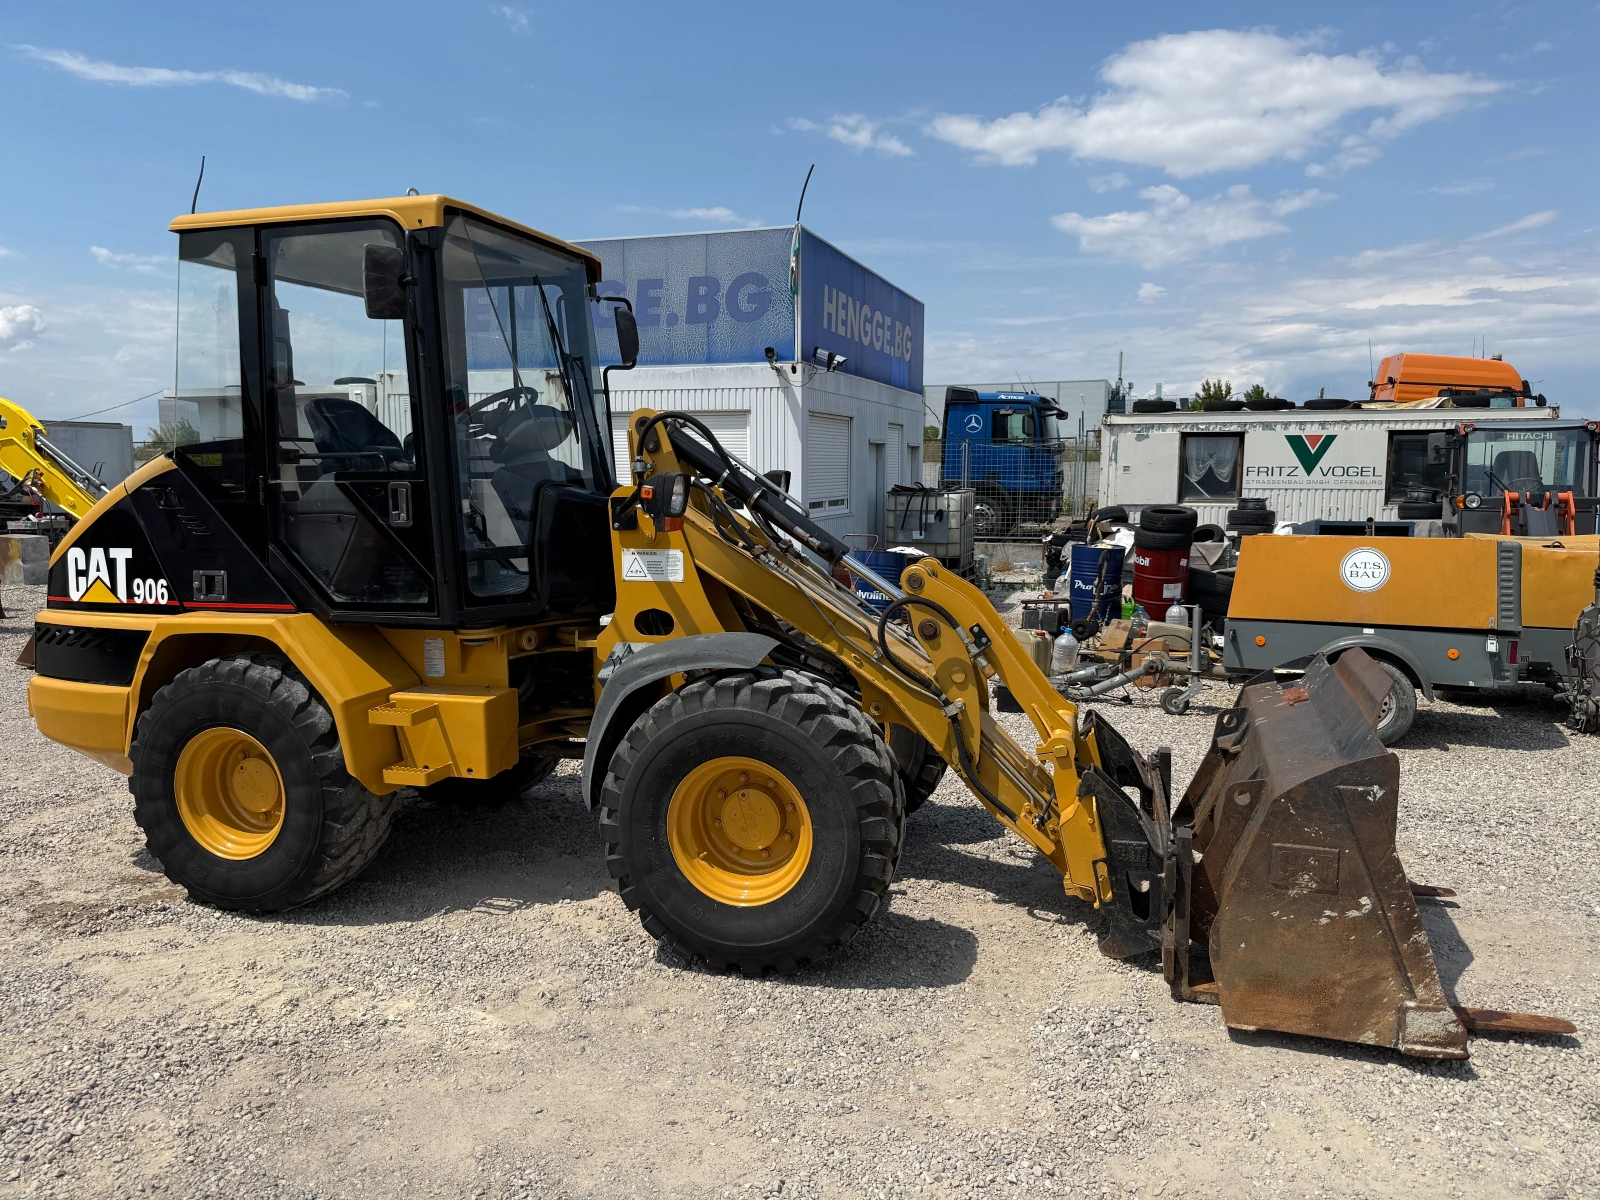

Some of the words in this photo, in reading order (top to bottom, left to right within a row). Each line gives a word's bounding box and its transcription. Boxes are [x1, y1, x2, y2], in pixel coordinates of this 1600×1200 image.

[823, 284, 912, 362] HENGGE.BG
[1506, 432, 1553, 440] HITACHI
[1245, 466, 1299, 477] FRITZ
[1319, 466, 1383, 477] VOGEL
[1134, 553, 1150, 567] obil
[1349, 561, 1383, 570] A.T.S.
[67, 547, 133, 603] CAT
[132, 577, 169, 605] 906
[1349, 570, 1382, 579] BAU
